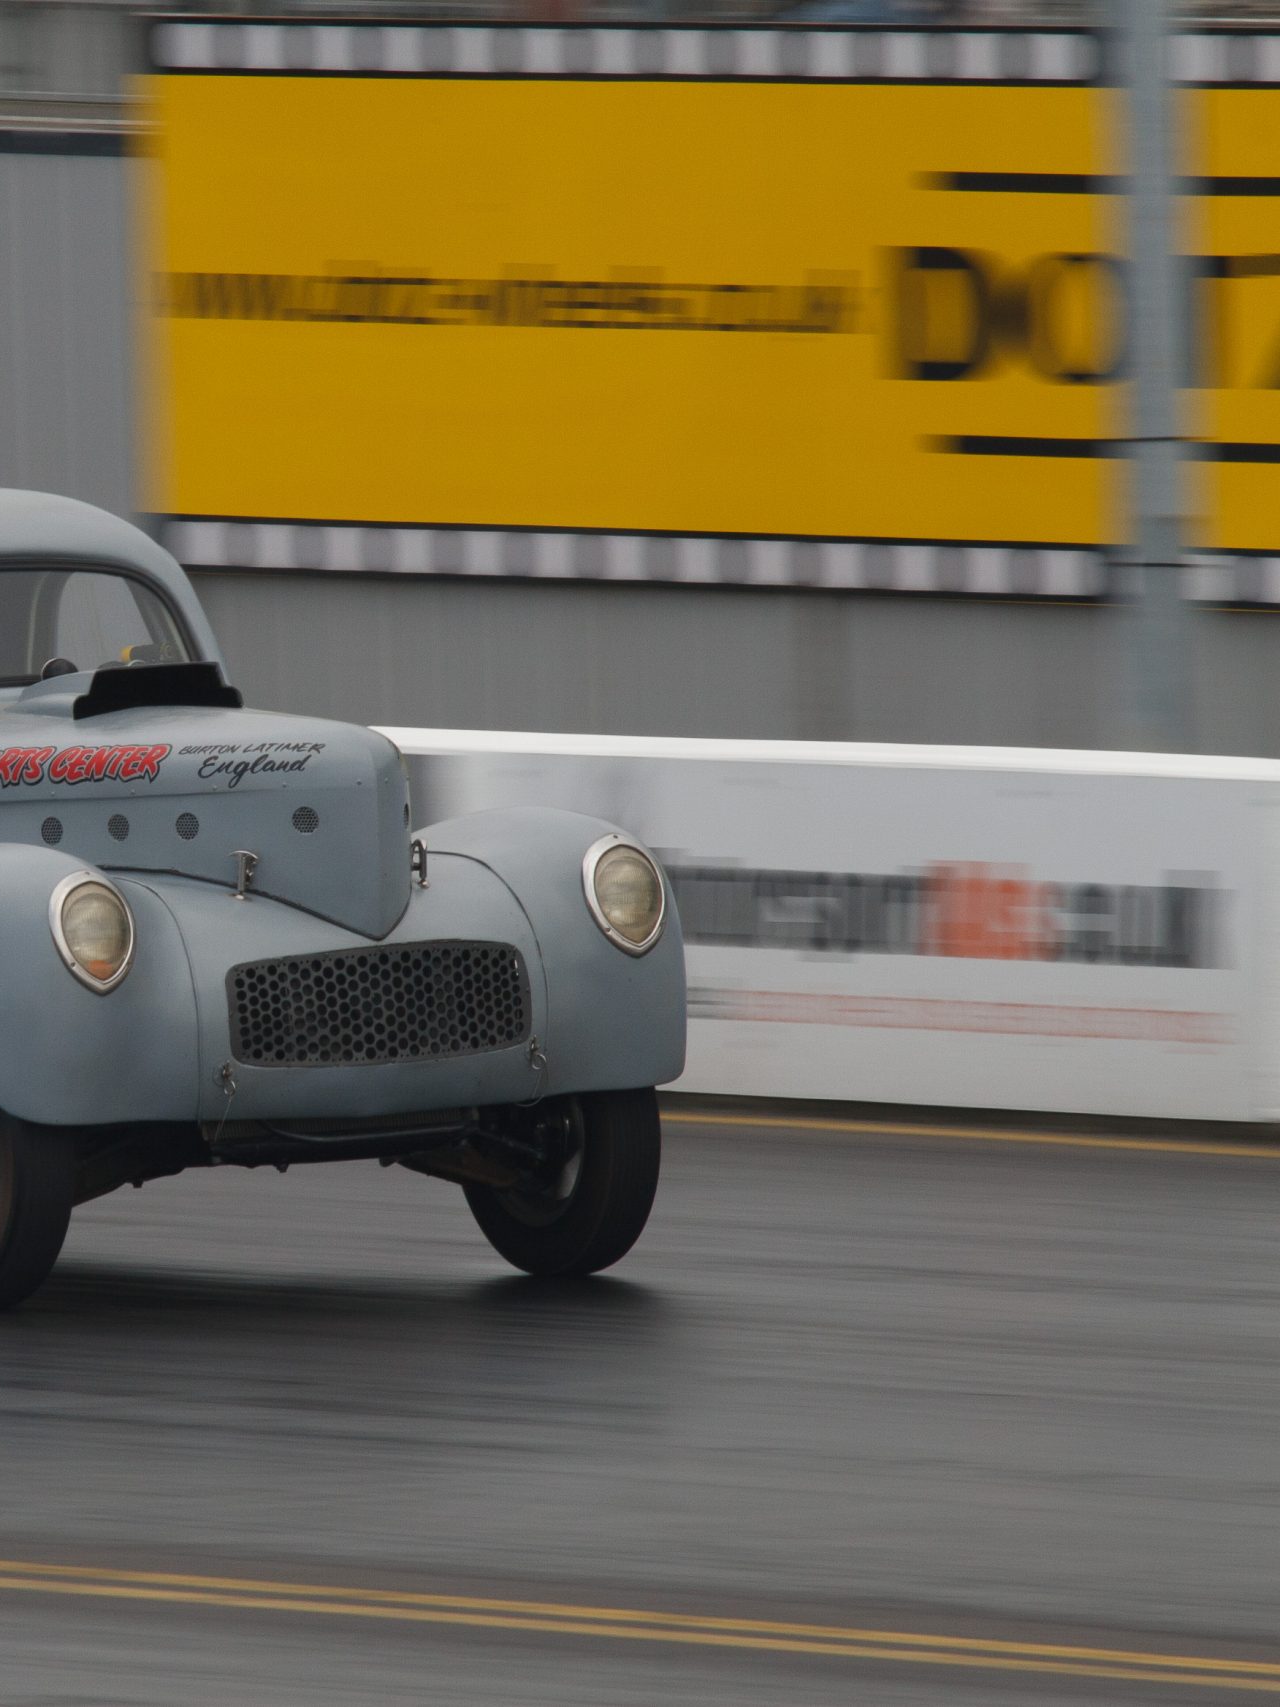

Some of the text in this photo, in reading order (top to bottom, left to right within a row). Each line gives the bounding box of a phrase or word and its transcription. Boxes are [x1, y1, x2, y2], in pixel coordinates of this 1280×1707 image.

[48, 744, 173, 786] CENTER
[178, 742, 326, 755] BURTON LATIMER
[197, 753, 312, 789] England
